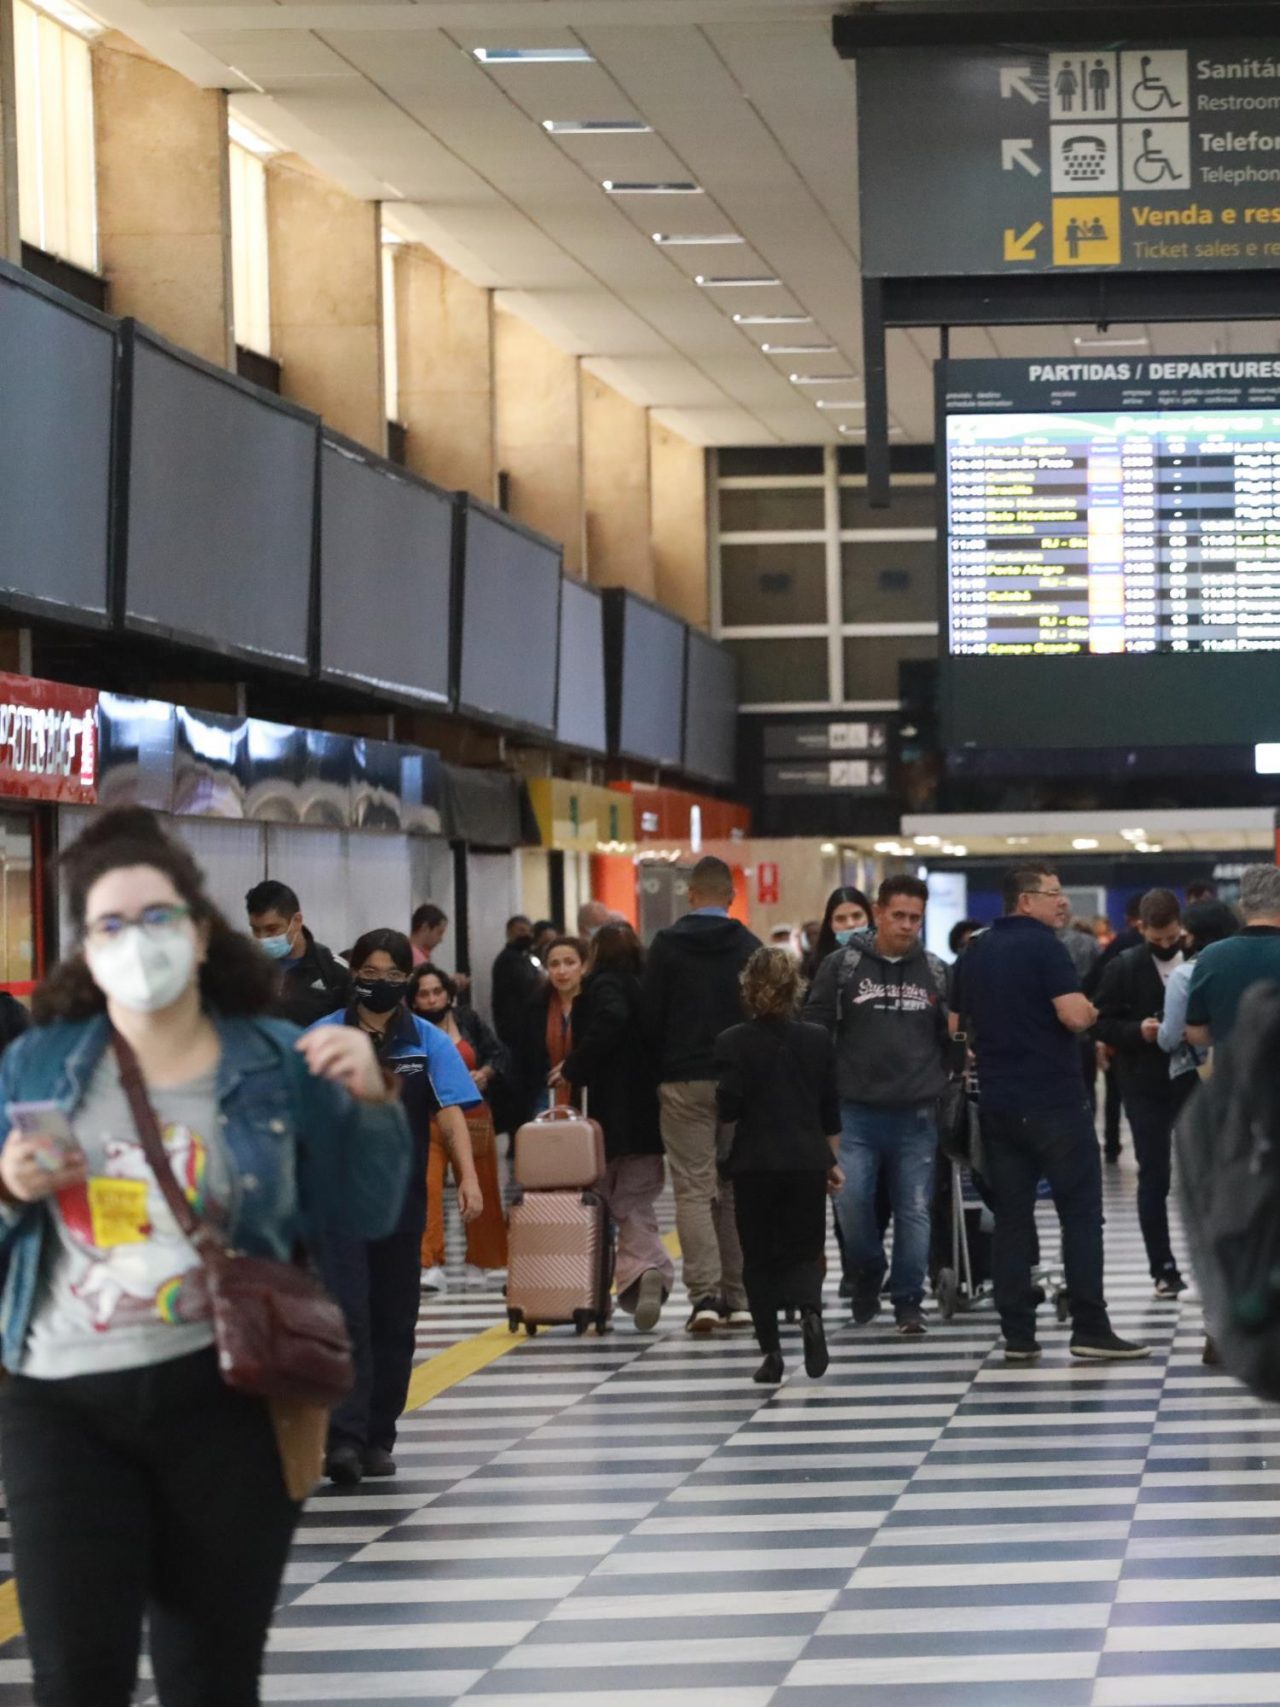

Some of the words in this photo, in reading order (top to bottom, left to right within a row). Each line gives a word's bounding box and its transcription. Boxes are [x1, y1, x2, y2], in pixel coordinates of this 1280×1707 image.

[1132, 204, 1213, 227] Venda
[1221, 209, 1236, 224] e
[1133, 240, 1189, 260] Ticket
[1194, 239, 1240, 258] sales
[1246, 243, 1258, 256] e
[1029, 364, 1130, 381] PARTIDAS
